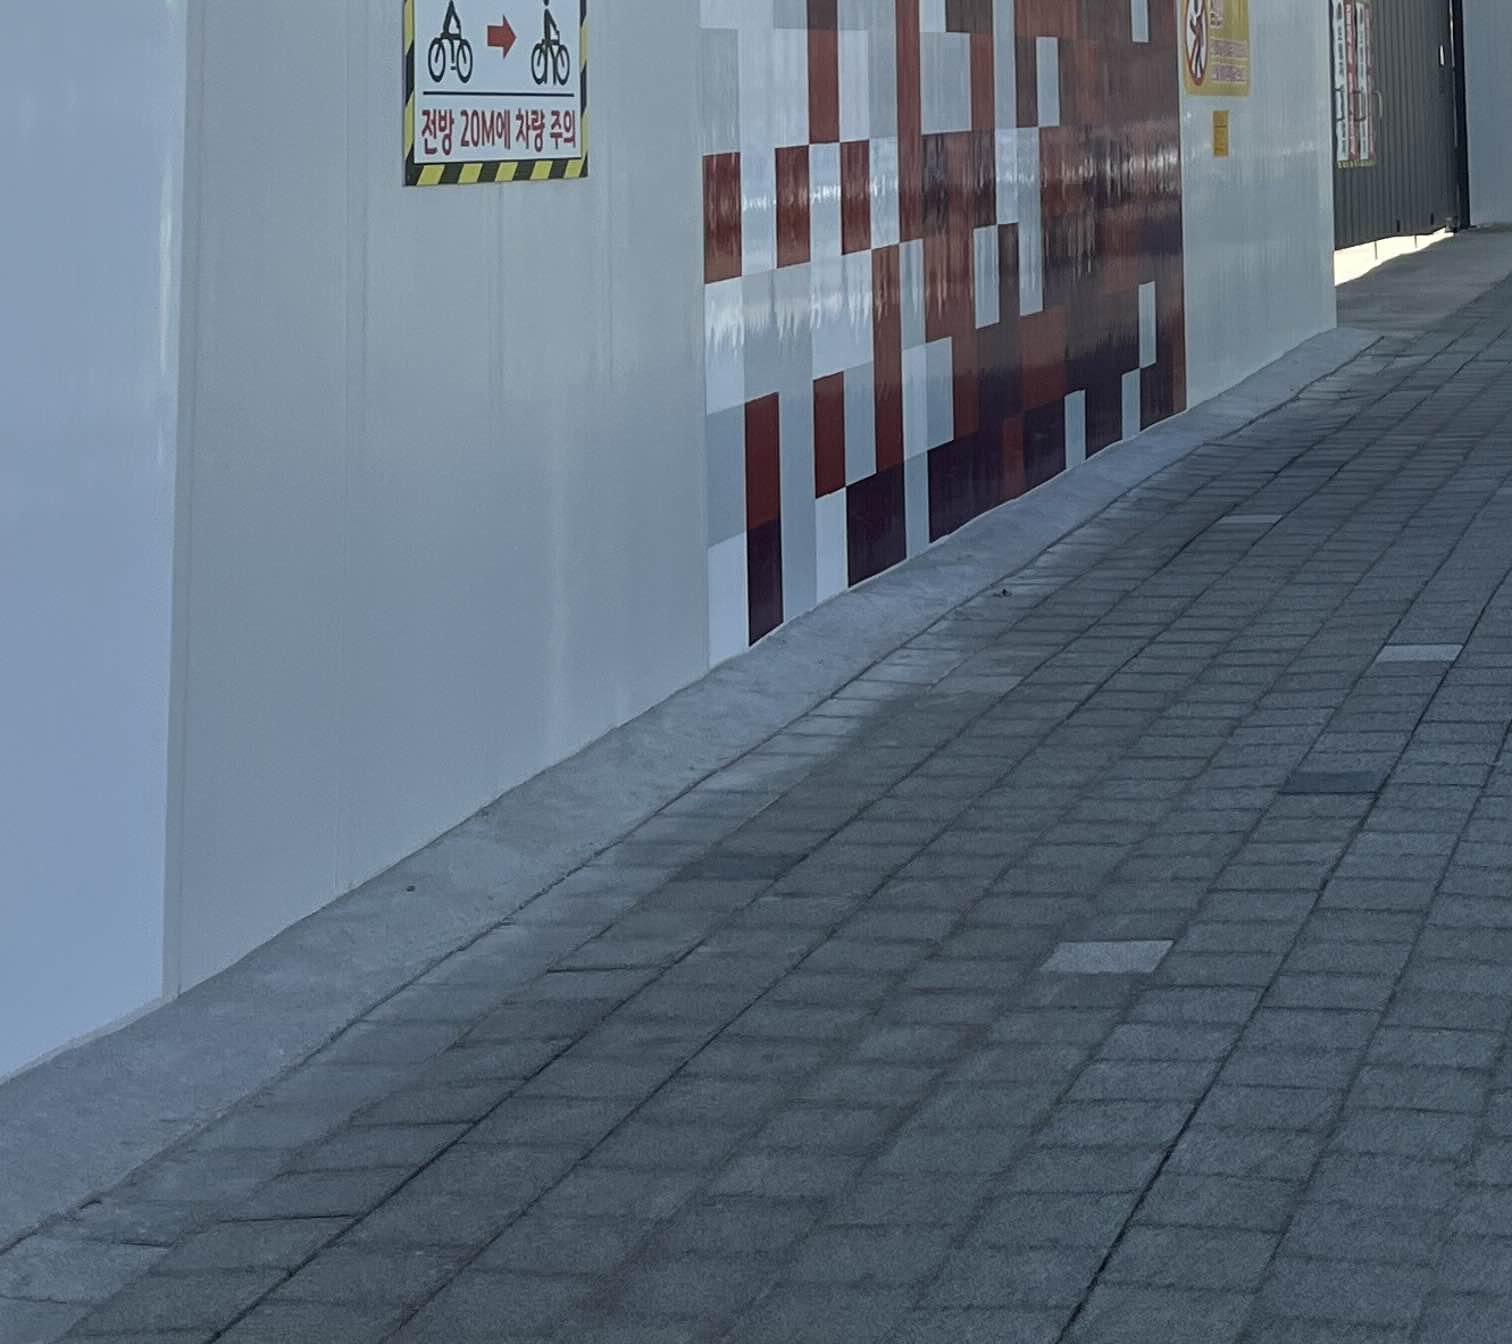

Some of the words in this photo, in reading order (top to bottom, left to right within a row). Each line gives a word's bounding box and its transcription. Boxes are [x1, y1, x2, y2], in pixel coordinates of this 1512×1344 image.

[421, 108, 455, 156] 전방
[460, 109, 511, 150] 20M에
[515, 109, 546, 153] 차량
[550, 109, 577, 150] 주의
